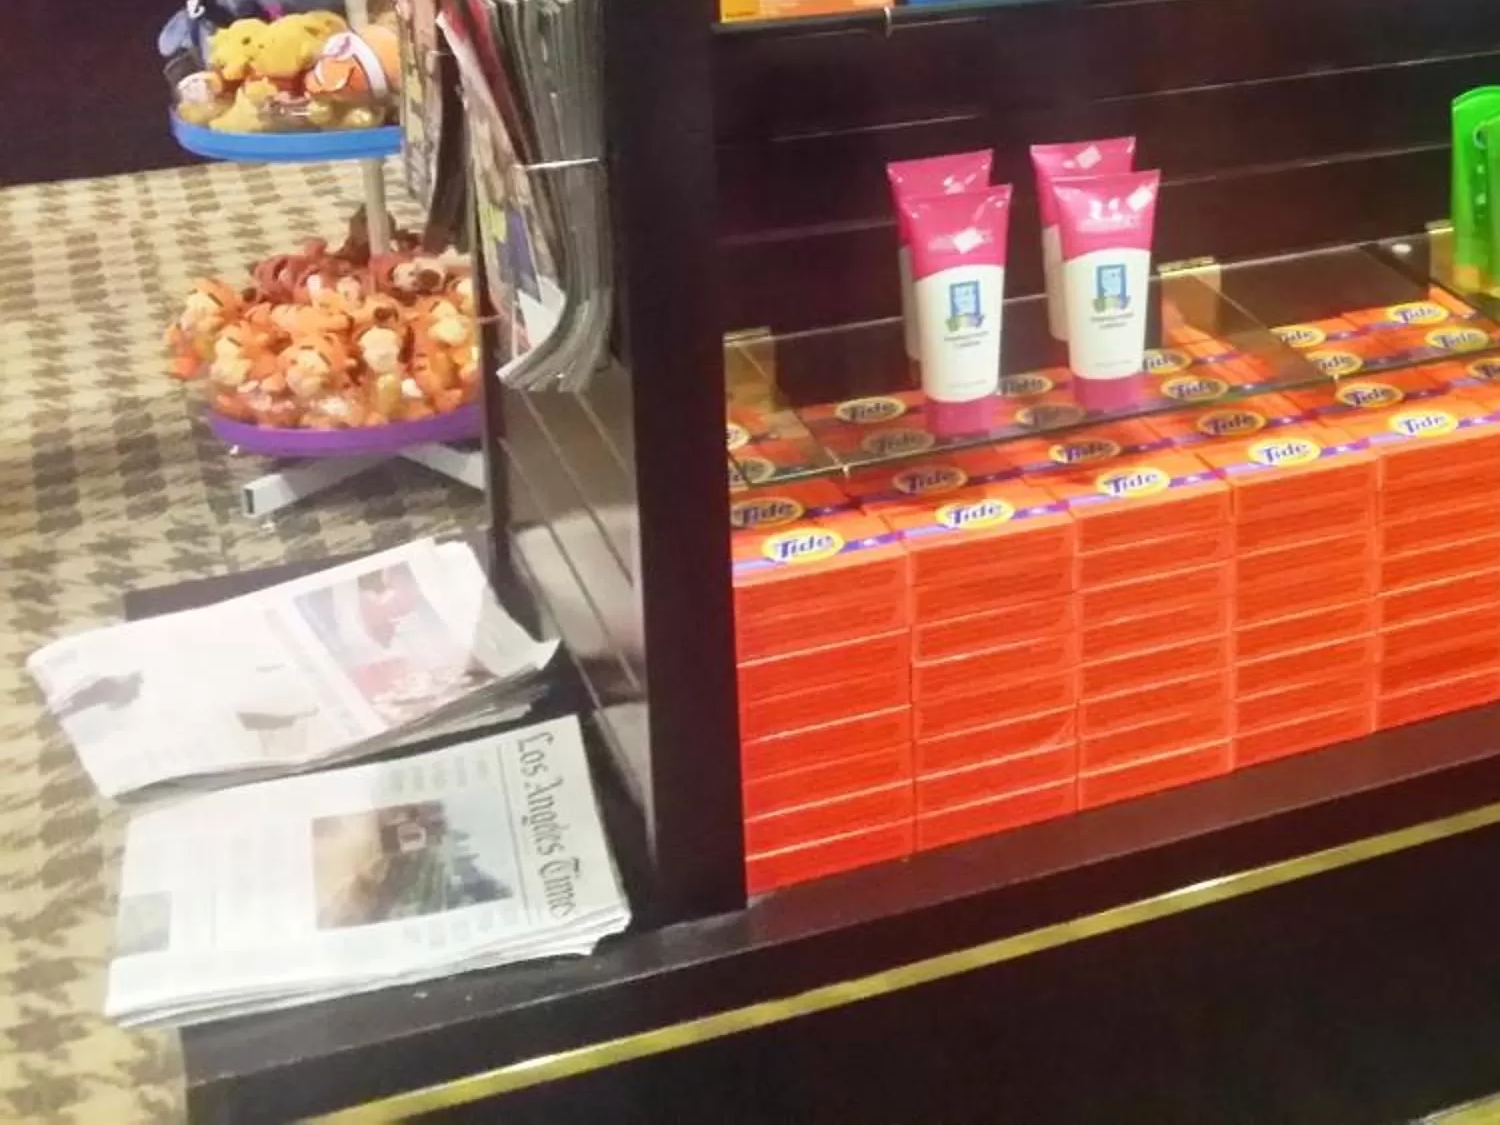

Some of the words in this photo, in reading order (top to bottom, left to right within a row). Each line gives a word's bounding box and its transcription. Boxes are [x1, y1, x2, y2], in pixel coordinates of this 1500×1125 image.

[1400, 306, 1438, 323] Tide
[1437, 331, 1477, 346] Tide
[1174, 381, 1212, 398] Tide
[1350, 387, 1389, 406] Tide
[851, 401, 894, 417] Tide
[1209, 414, 1252, 434] Tide
[1403, 414, 1447, 433] Tide
[1065, 442, 1111, 461] Tide
[1258, 442, 1309, 464] Tide
[904, 472, 957, 493] Tide
[1104, 471, 1159, 495] Tide
[737, 503, 793, 525] Tide
[950, 504, 1002, 526] Tide
[777, 534, 834, 560] Tide
[518, 731, 555, 775] Los
[522, 776, 571, 856] Angeles
